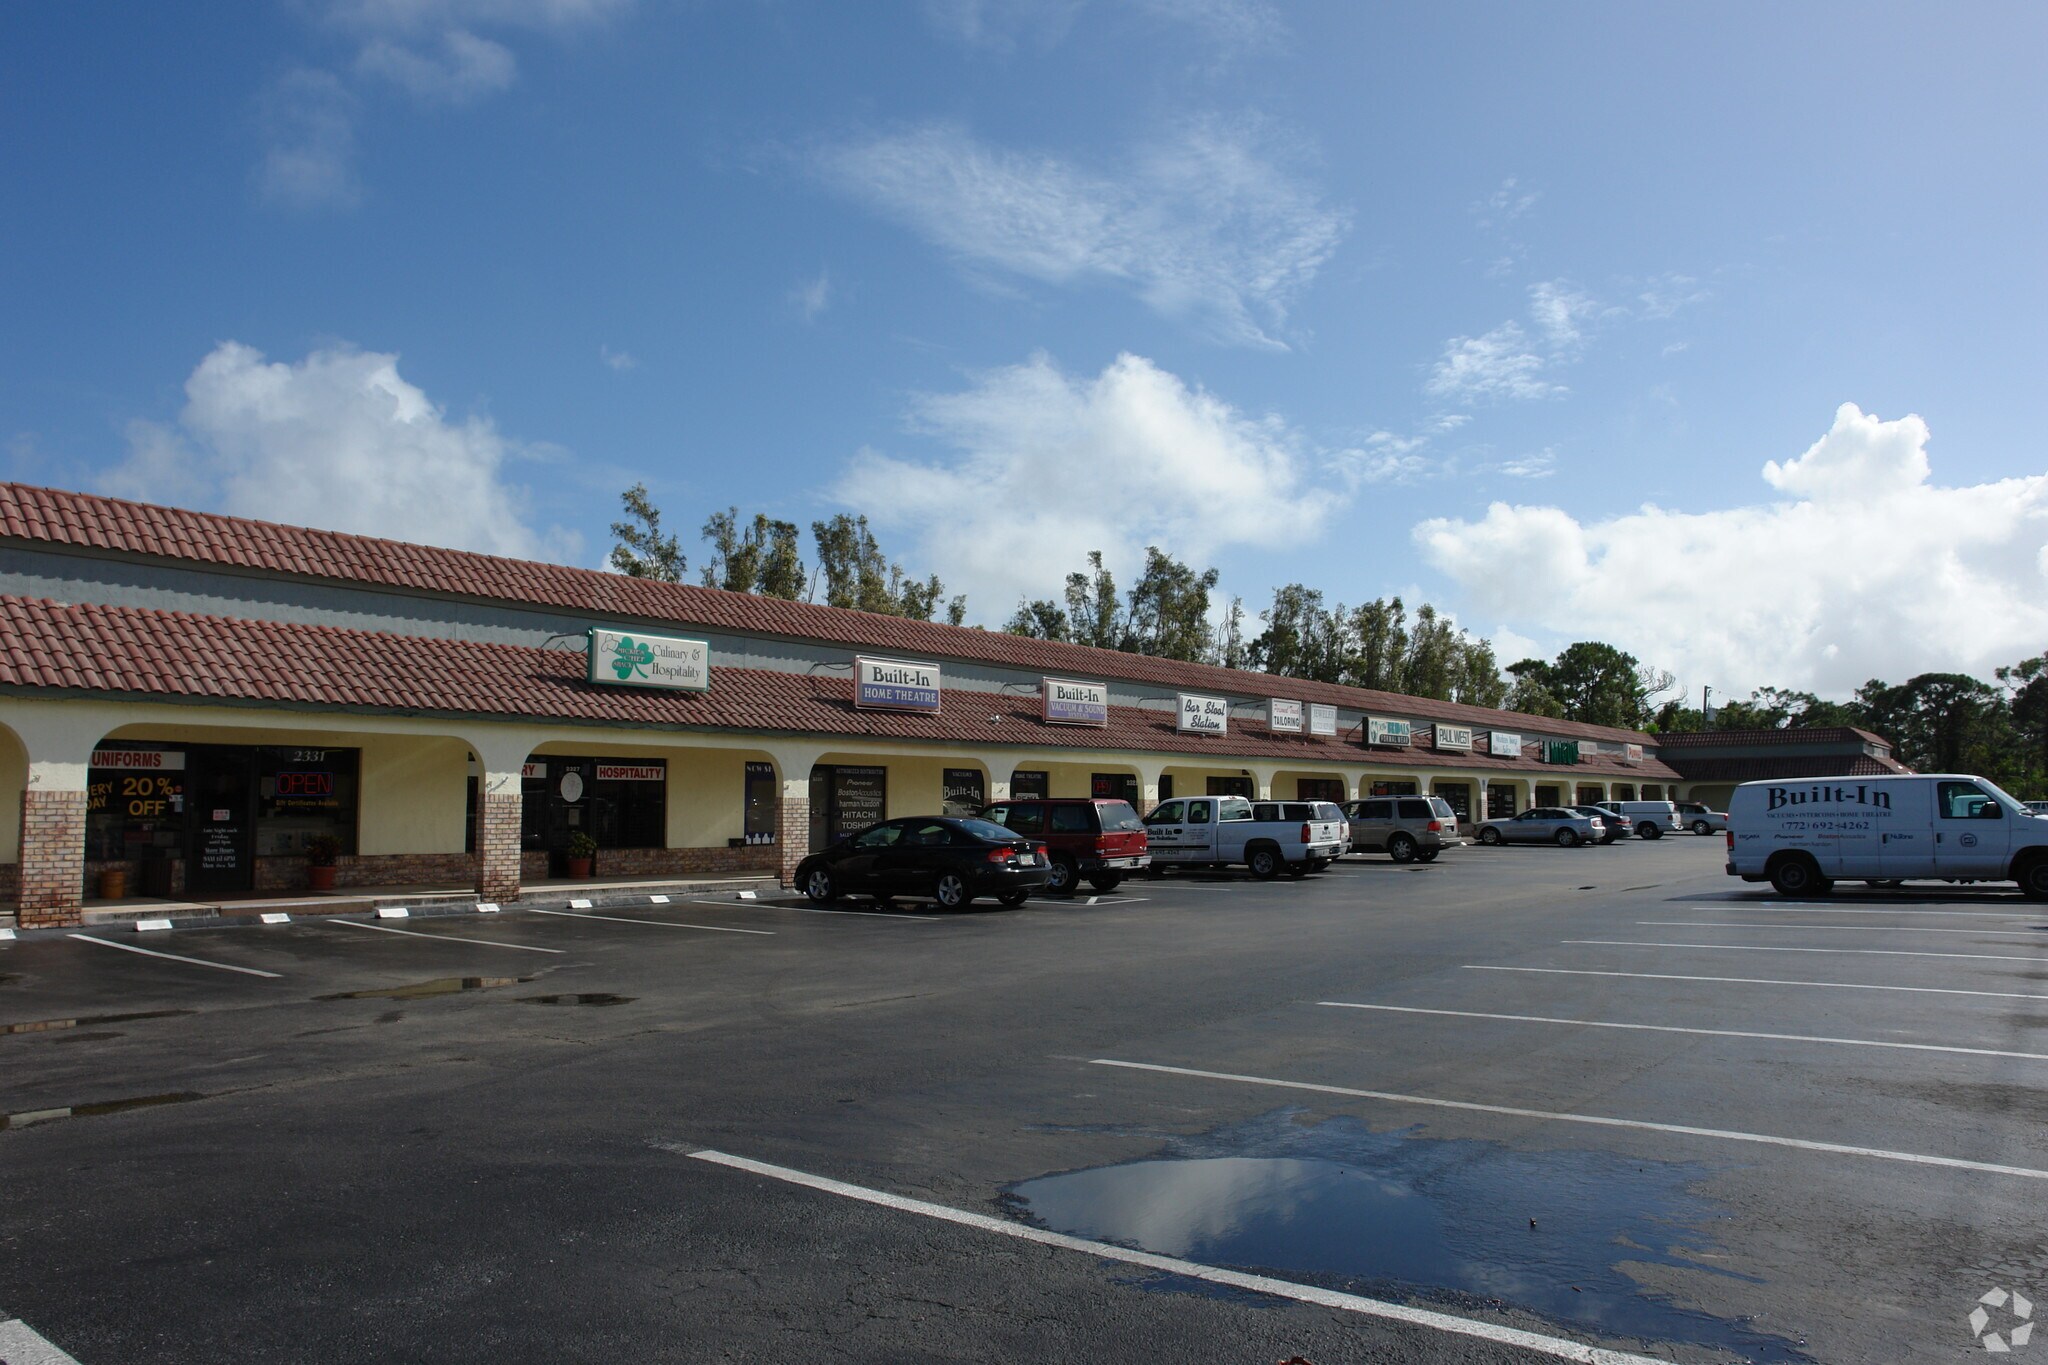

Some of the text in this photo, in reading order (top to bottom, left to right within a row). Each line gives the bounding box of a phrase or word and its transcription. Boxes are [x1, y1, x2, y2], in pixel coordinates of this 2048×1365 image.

[653, 644, 702, 663] Culinary &
[652, 662, 702, 682] Hospitality
[872, 666, 931, 687] Built-In
[864, 688, 937, 703] HOME THEATRE
[1057, 686, 1100, 703] Built-In
[1051, 702, 1077, 713] VACUUM
[1085, 704, 1106, 715] SOUND
[1184, 699, 1226, 716] Bar Stool
[1190, 714, 1221, 730] Station
[1274, 716, 1300, 728] TAILORING
[1439, 728, 1471, 744] PAUL WEST
[91, 752, 162, 767] UNIFORMS
[293, 750, 325, 762] 2331
[599, 766, 661, 779] HOSPITALITY
[87, 781, 113, 797] ERY
[278, 773, 332, 795] OPEN
[847, 778, 874, 786] Pioneer
[943, 785, 981, 800] Built-In
[1766, 785, 1892, 811] Built-In
[128, 799, 167, 816] OFF
[842, 811, 878, 819] HITACHI
[1766, 811, 1892, 819] VACUUMS INTERCOMS HOME THEATRE
[1147, 828, 1173, 836] Built In
[1781, 820, 1870, 831] (772) 692-4262
